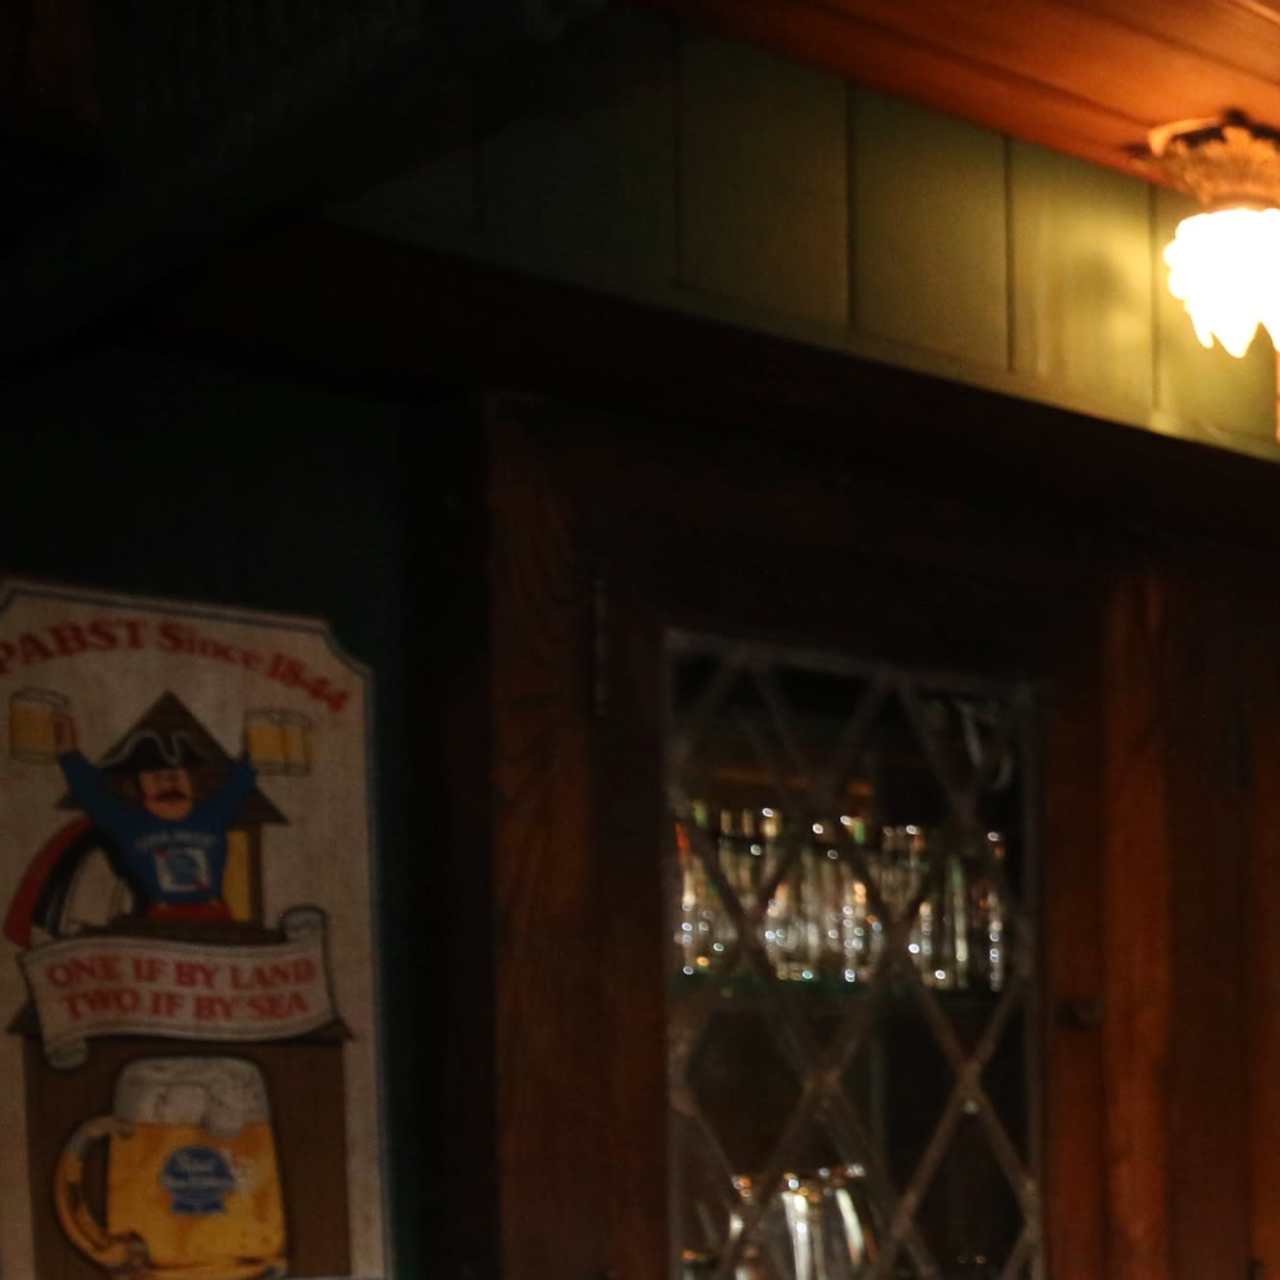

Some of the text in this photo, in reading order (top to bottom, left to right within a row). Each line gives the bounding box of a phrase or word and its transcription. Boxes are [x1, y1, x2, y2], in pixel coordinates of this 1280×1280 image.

[158, 621, 262, 674] Since
[45, 955, 316, 991] ONE IF BY LAND
[62, 988, 309, 1022] TWO IF BY SEA
